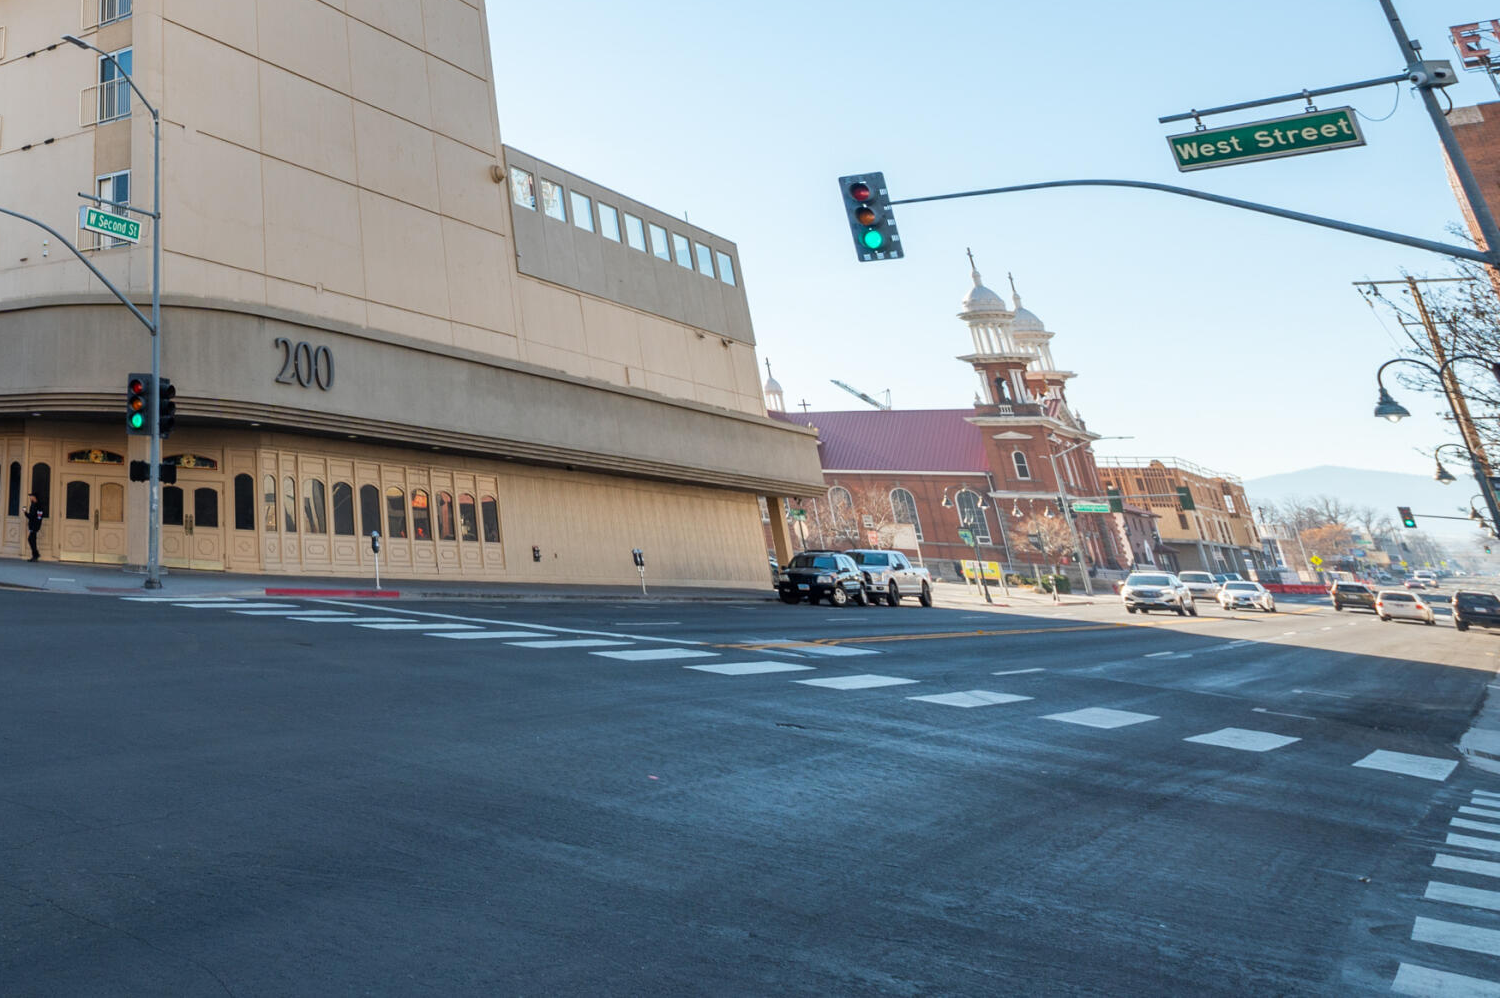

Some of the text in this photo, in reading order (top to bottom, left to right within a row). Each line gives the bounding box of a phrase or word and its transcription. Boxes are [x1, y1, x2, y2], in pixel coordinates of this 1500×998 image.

[1175, 117, 1352, 161] West Street
[89, 212, 138, 237] W Second St
[274, 337, 336, 391] 200
